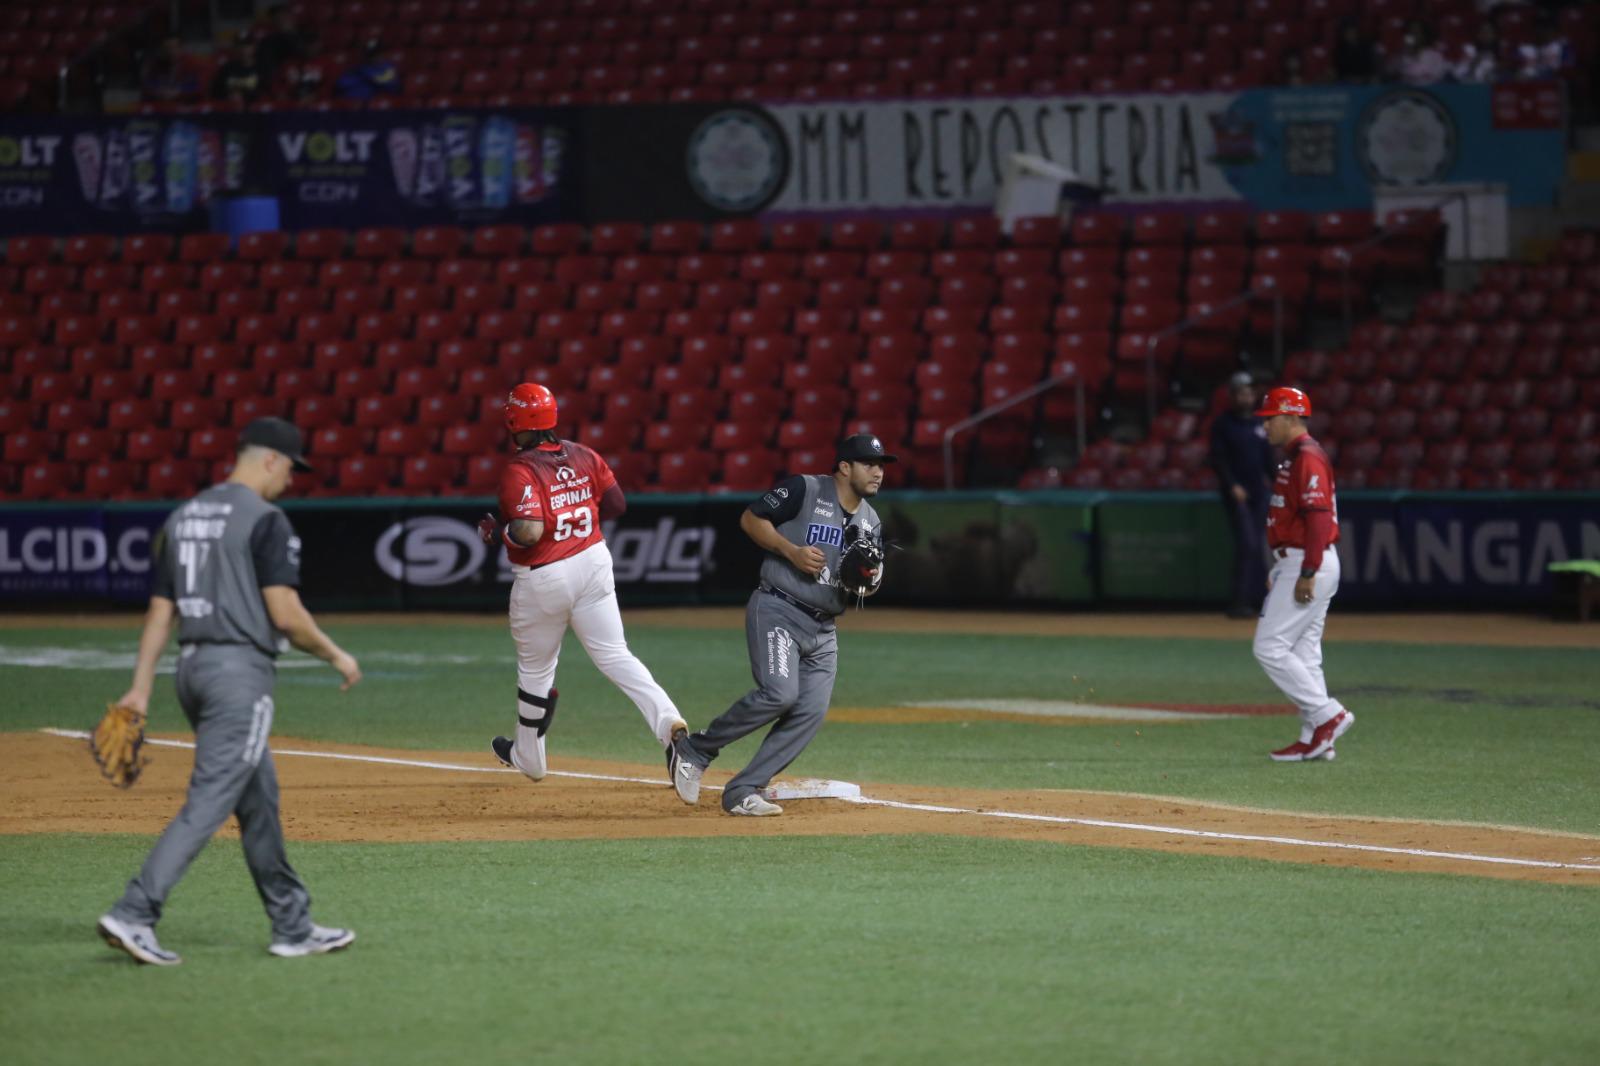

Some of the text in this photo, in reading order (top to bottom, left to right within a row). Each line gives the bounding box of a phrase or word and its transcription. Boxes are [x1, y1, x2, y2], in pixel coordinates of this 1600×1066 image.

[277, 130, 378, 162] VOLT
[798, 110, 869, 201] MM
[903, 101, 1202, 198] REPOSTERIA
[550, 486, 593, 511] ESPINAL
[553, 505, 593, 542] 53
